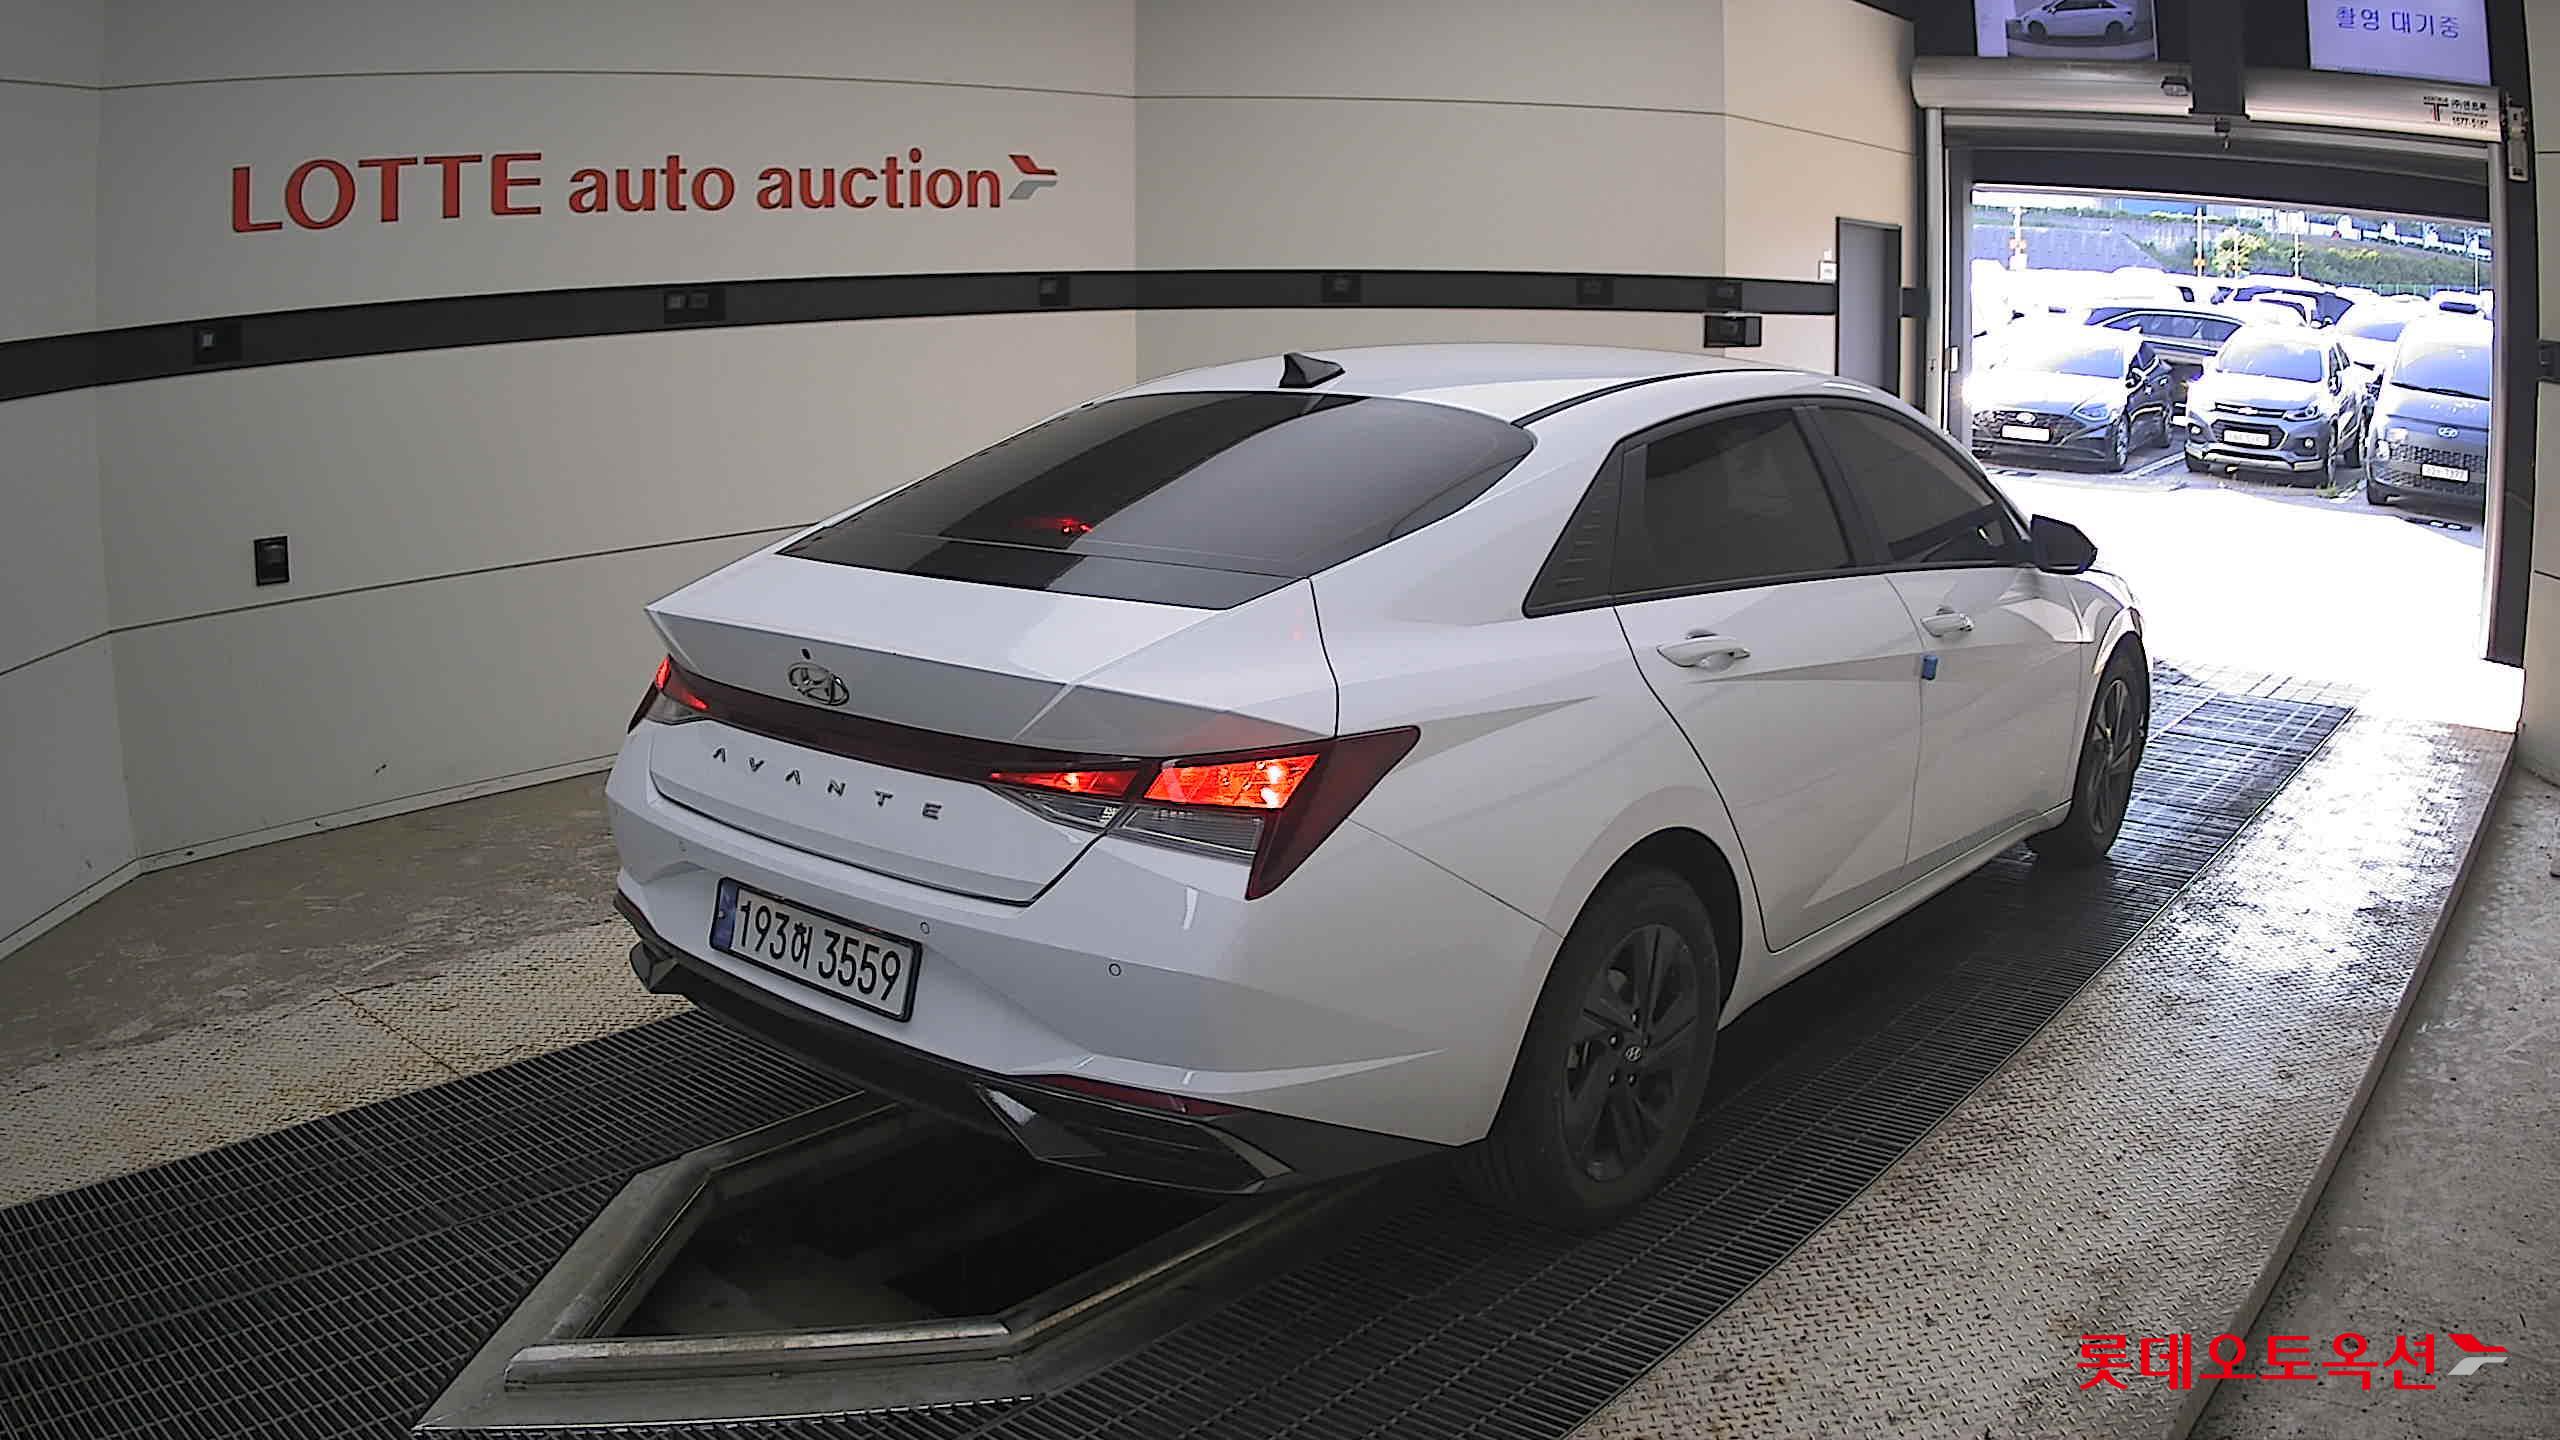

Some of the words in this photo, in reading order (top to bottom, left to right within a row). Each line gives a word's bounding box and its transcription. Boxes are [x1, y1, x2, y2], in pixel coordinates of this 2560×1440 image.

[2336, 6, 2380, 31] 촬영
[2391, 11, 2459, 39] 대기중
[232, 152, 543, 233] LOTTE
[568, 155, 736, 213] auto
[757, 148, 1002, 209] auction
[712, 747, 943, 821] AVANTE
[740, 900, 813, 970] 193허
[817, 928, 901, 1001] 3559
